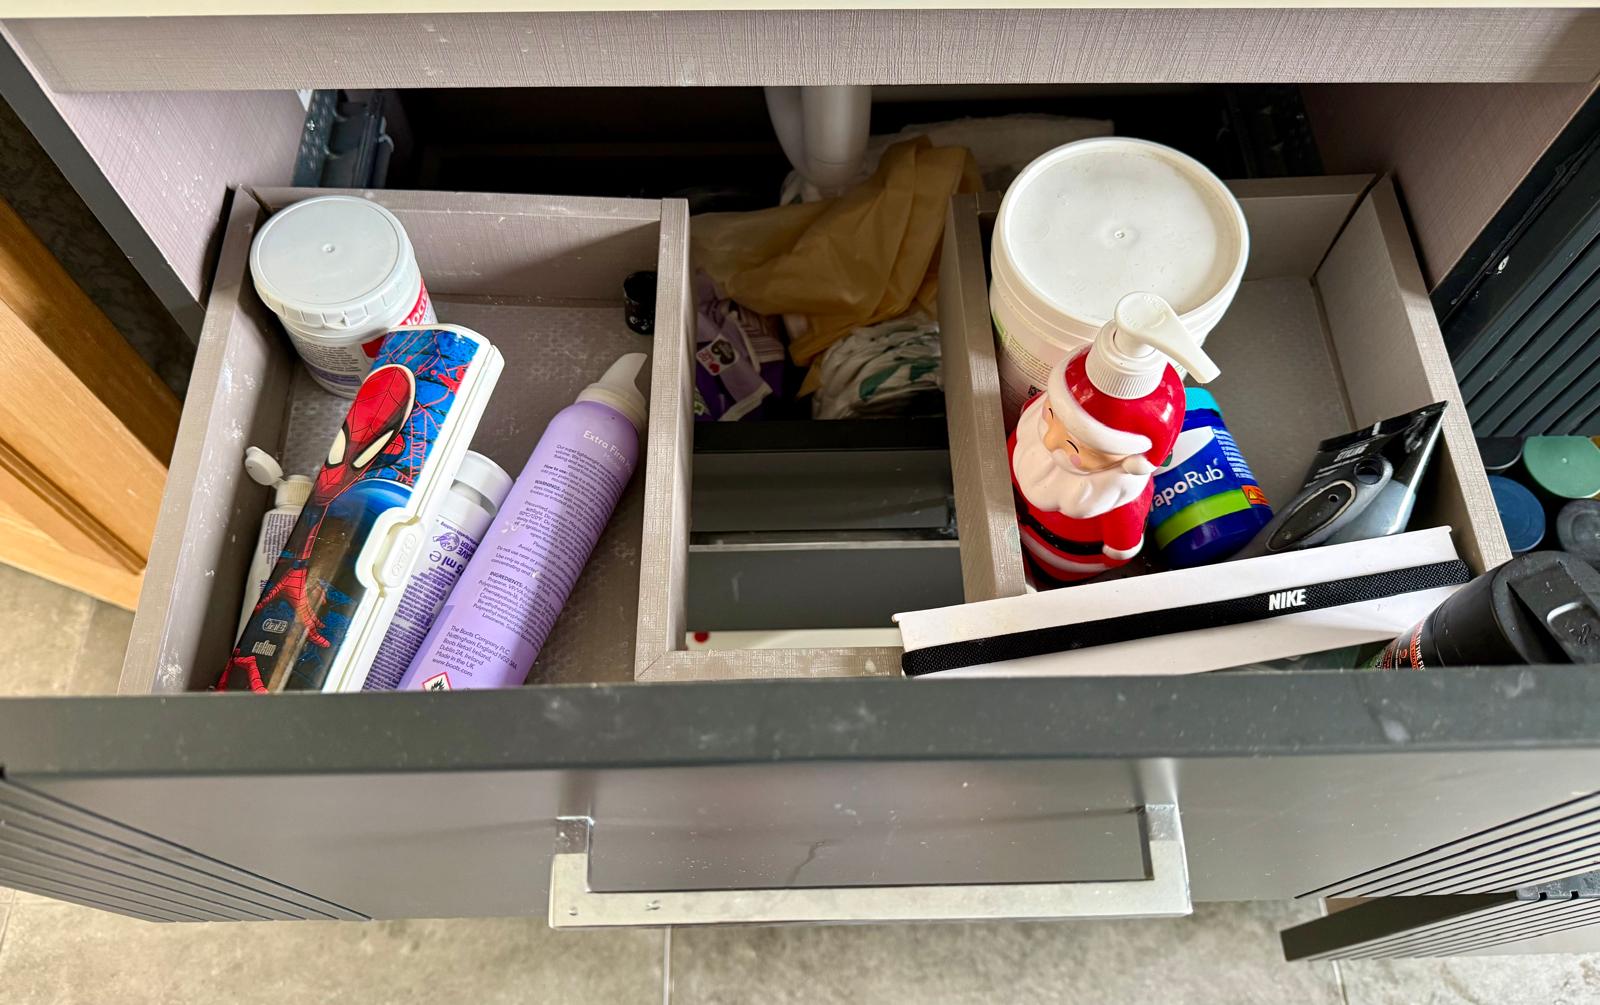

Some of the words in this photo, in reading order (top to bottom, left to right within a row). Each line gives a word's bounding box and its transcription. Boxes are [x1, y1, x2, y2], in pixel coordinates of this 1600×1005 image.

[583, 430, 609, 449] Extra
[609, 444, 627, 463] Firm
[534, 479, 561, 491] WARNINGS:
[1149, 464, 1224, 512] apoRub
[518, 543, 531, 552] Avoid
[441, 556, 457, 568] ml
[489, 570, 523, 587] INGREDIENTS:
[1269, 588, 1306, 611] NIKE
[442, 637, 455, 647] Boots
[456, 642, 471, 652] Retail
[471, 648, 492, 662] Ireland,
[446, 631, 475, 647] Nottingham
[476, 642, 498, 657] England
[459, 628, 474, 637] Boots
[474, 633, 499, 649] Company
[499, 645, 510, 655] PLC
[435, 650, 450, 660] Made
[465, 661, 474, 669] UK
[439, 643, 455, 654] Dublin
[455, 649, 463, 657] 24,
[464, 653, 483, 665] Ireland
[432, 658, 473, 677] www.boots.com
